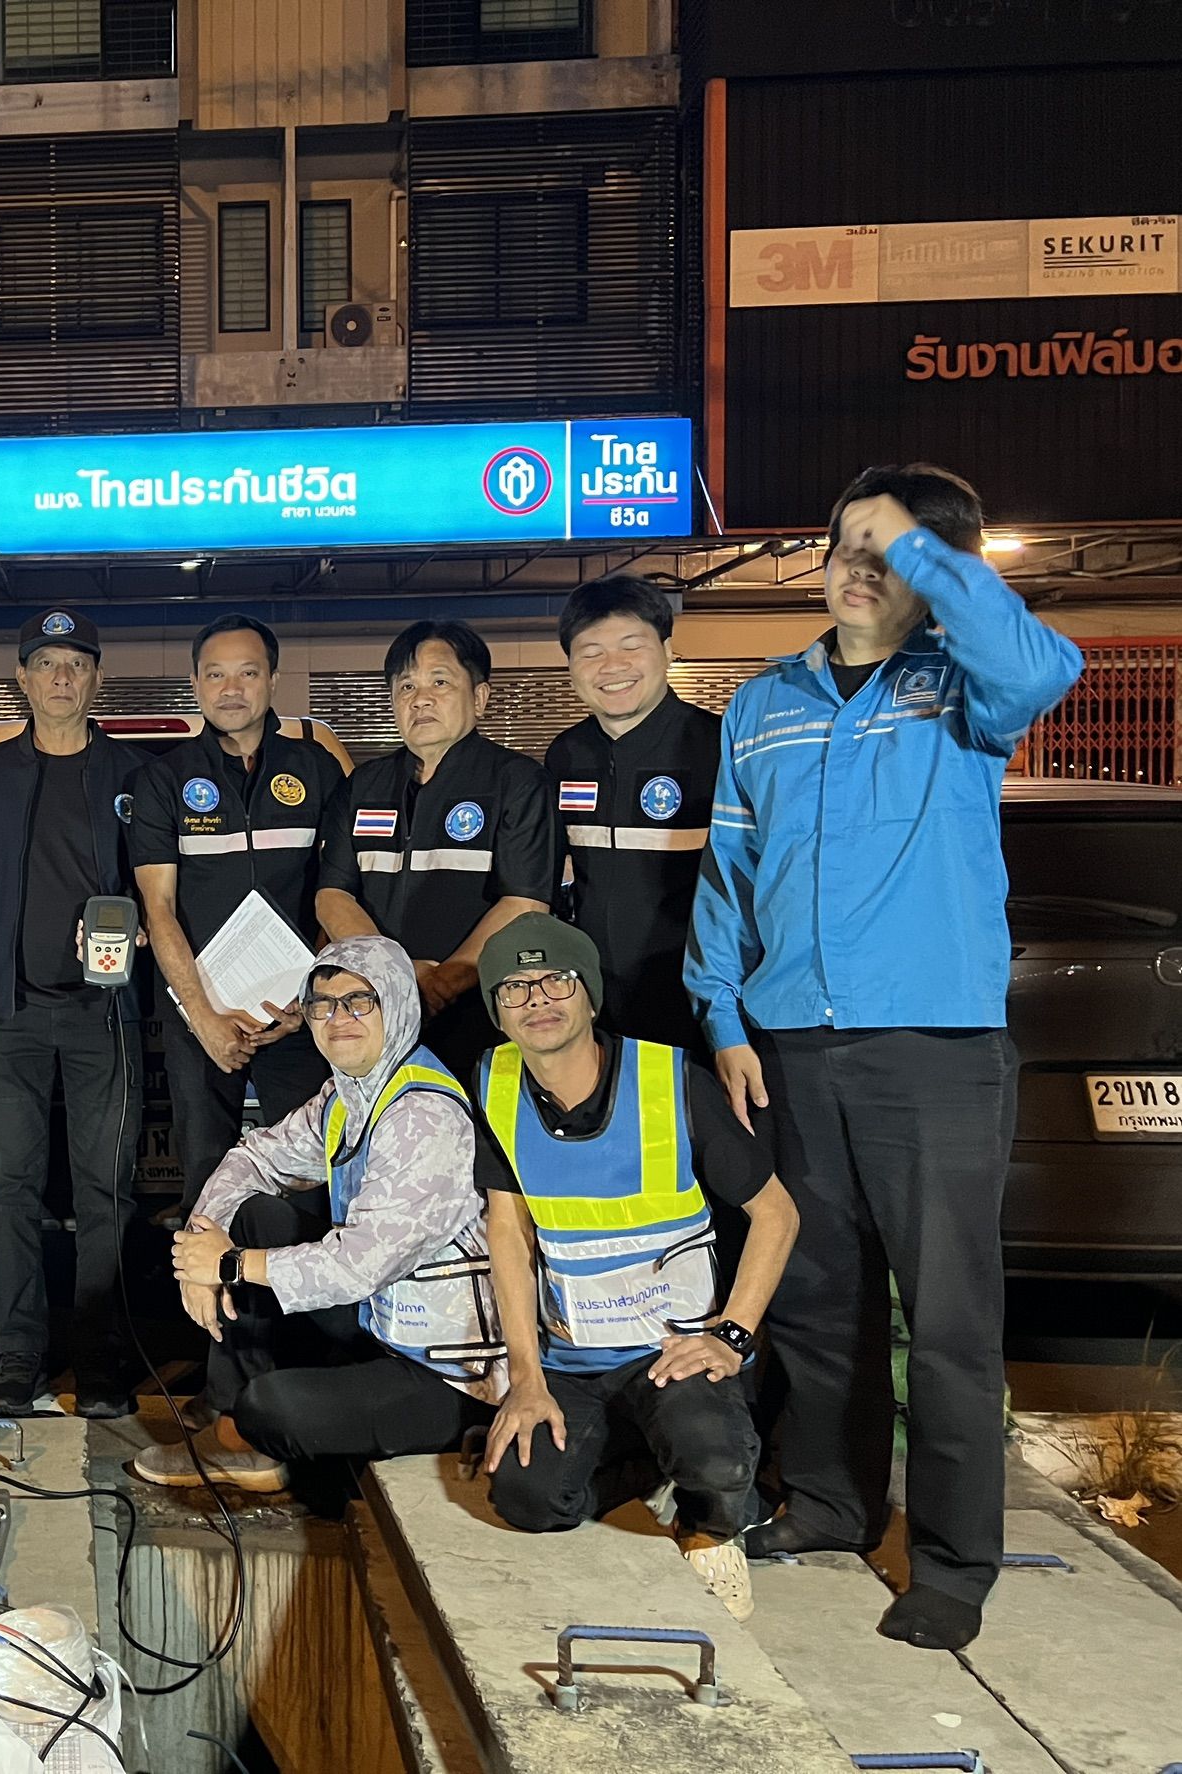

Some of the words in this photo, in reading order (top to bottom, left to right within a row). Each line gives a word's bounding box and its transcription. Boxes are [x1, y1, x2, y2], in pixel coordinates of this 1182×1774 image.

[1043, 234, 1164, 255] SEKURIT
[756, 238, 854, 293] 3M
[1118, 266, 1165, 277] MOTION
[590, 434, 657, 466] ไทย
[581, 465, 678, 495] ประกัน
[610, 506, 649, 526] ชีวิต
